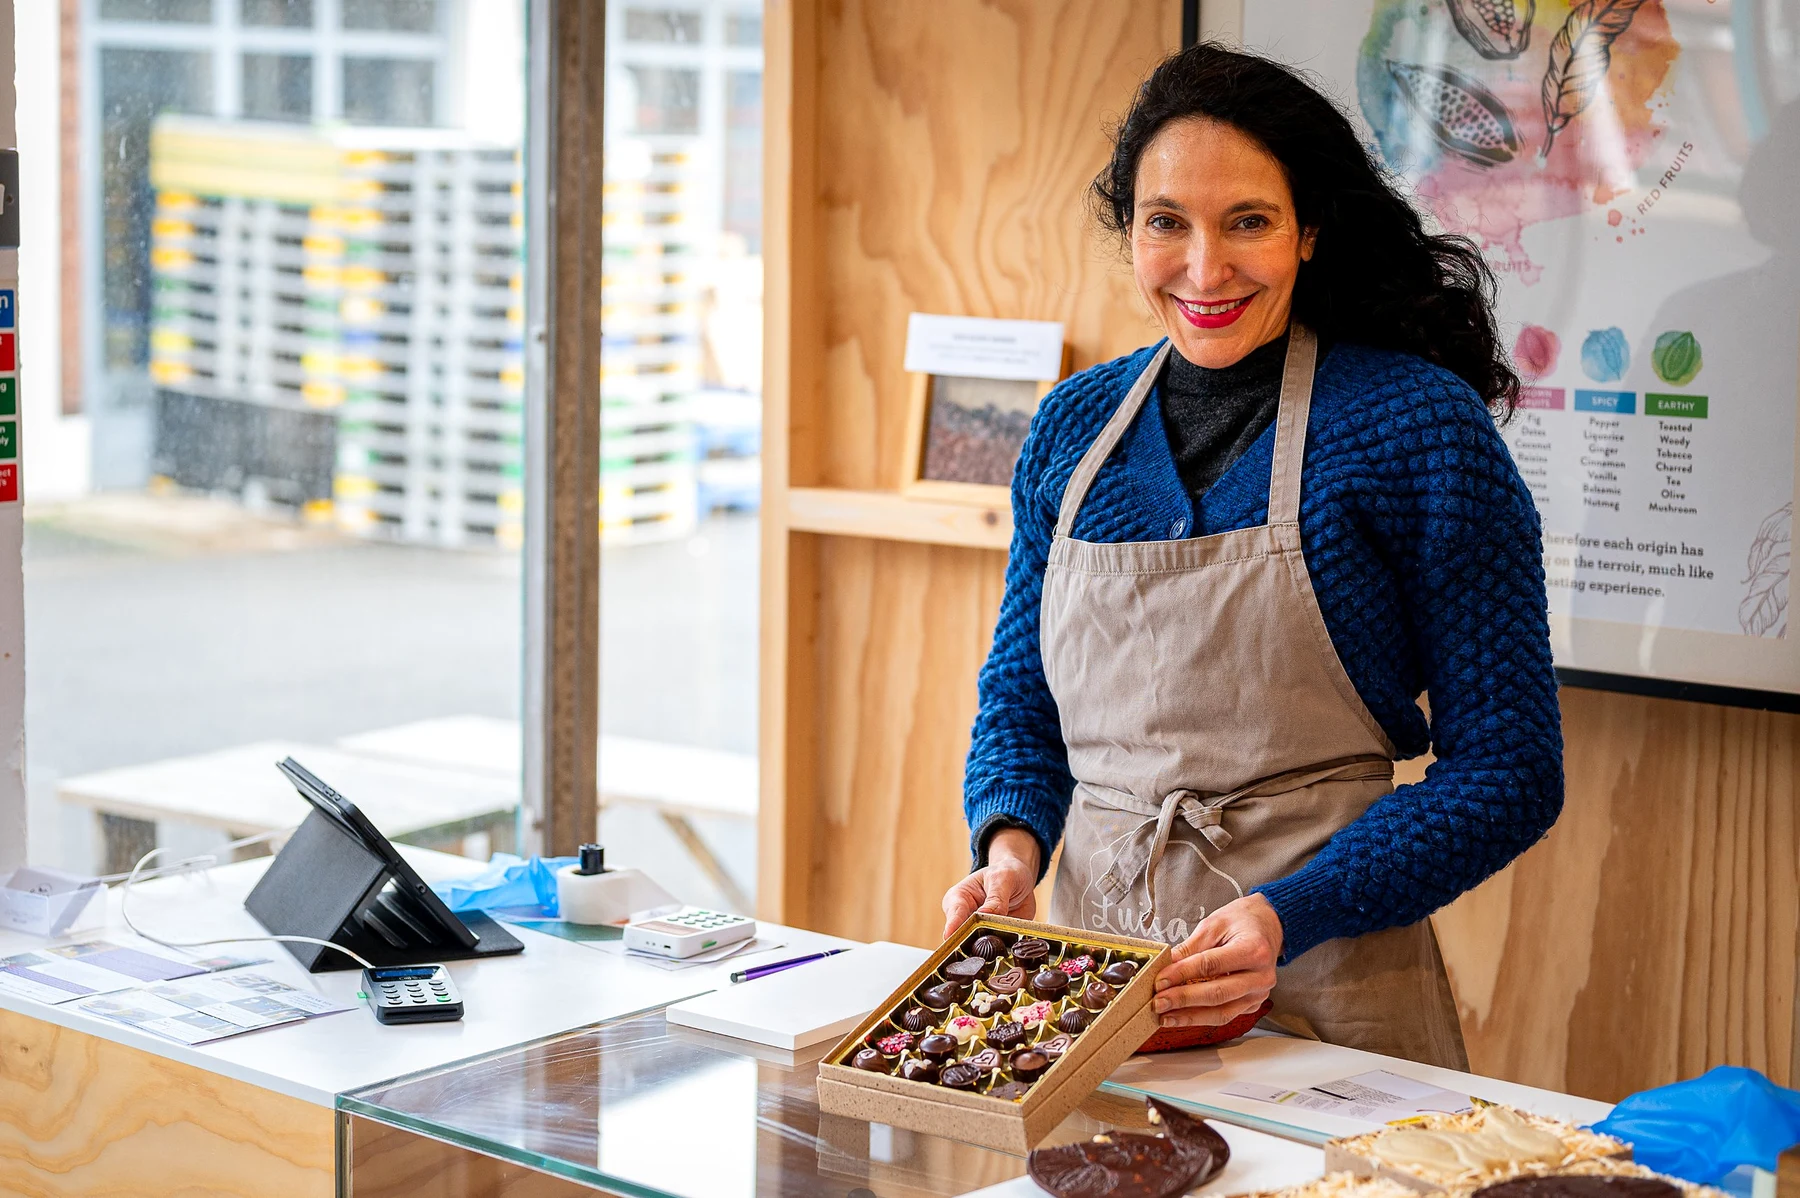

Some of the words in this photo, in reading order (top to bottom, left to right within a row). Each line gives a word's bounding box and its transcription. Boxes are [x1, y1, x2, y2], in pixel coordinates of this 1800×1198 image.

[1637, 188, 1661, 215] RED
[1659, 141, 1693, 189] FRUITS
[1591, 396, 1619, 407] SPICY
[1658, 400, 1695, 411] EARTHY
[1528, 414, 1541, 425] Fig
[1589, 416, 1619, 428] Pepper
[1521, 426, 1546, 436] Dates
[1659, 421, 1692, 432] Toasted
[1584, 431, 1624, 443] Liquorice
[1660, 435, 1690, 449] Woody
[1515, 439, 1551, 450] Coconut
[1588, 443, 1618, 456] Ginger
[1657, 448, 1692, 460] Tobacco
[1581, 456, 1626, 468] Cinnamon
[1656, 461, 1692, 473] Charred
[1588, 471, 1617, 481] Vanilla
[1666, 475, 1681, 486] Tea
[1583, 483, 1621, 495] Balsamic
[1661, 489, 1685, 499] Olive
[1584, 497, 1620, 511] Nutmeg
[1649, 502, 1697, 514] Mushroom
[1543, 531, 1600, 547] herefore
[1603, 536, 1634, 551] each
[1637, 540, 1677, 557] origin
[1681, 541, 1704, 556] has
[1554, 556, 1570, 565] on
[1574, 554, 1594, 568] the
[1598, 560, 1645, 576] terroir,
[1649, 563, 1685, 577] much
[1689, 564, 1714, 579] like
[1547, 577, 1586, 592] asting
[1589, 581, 1665, 597] experience.
[1091, 894, 1205, 942] Luisa'
